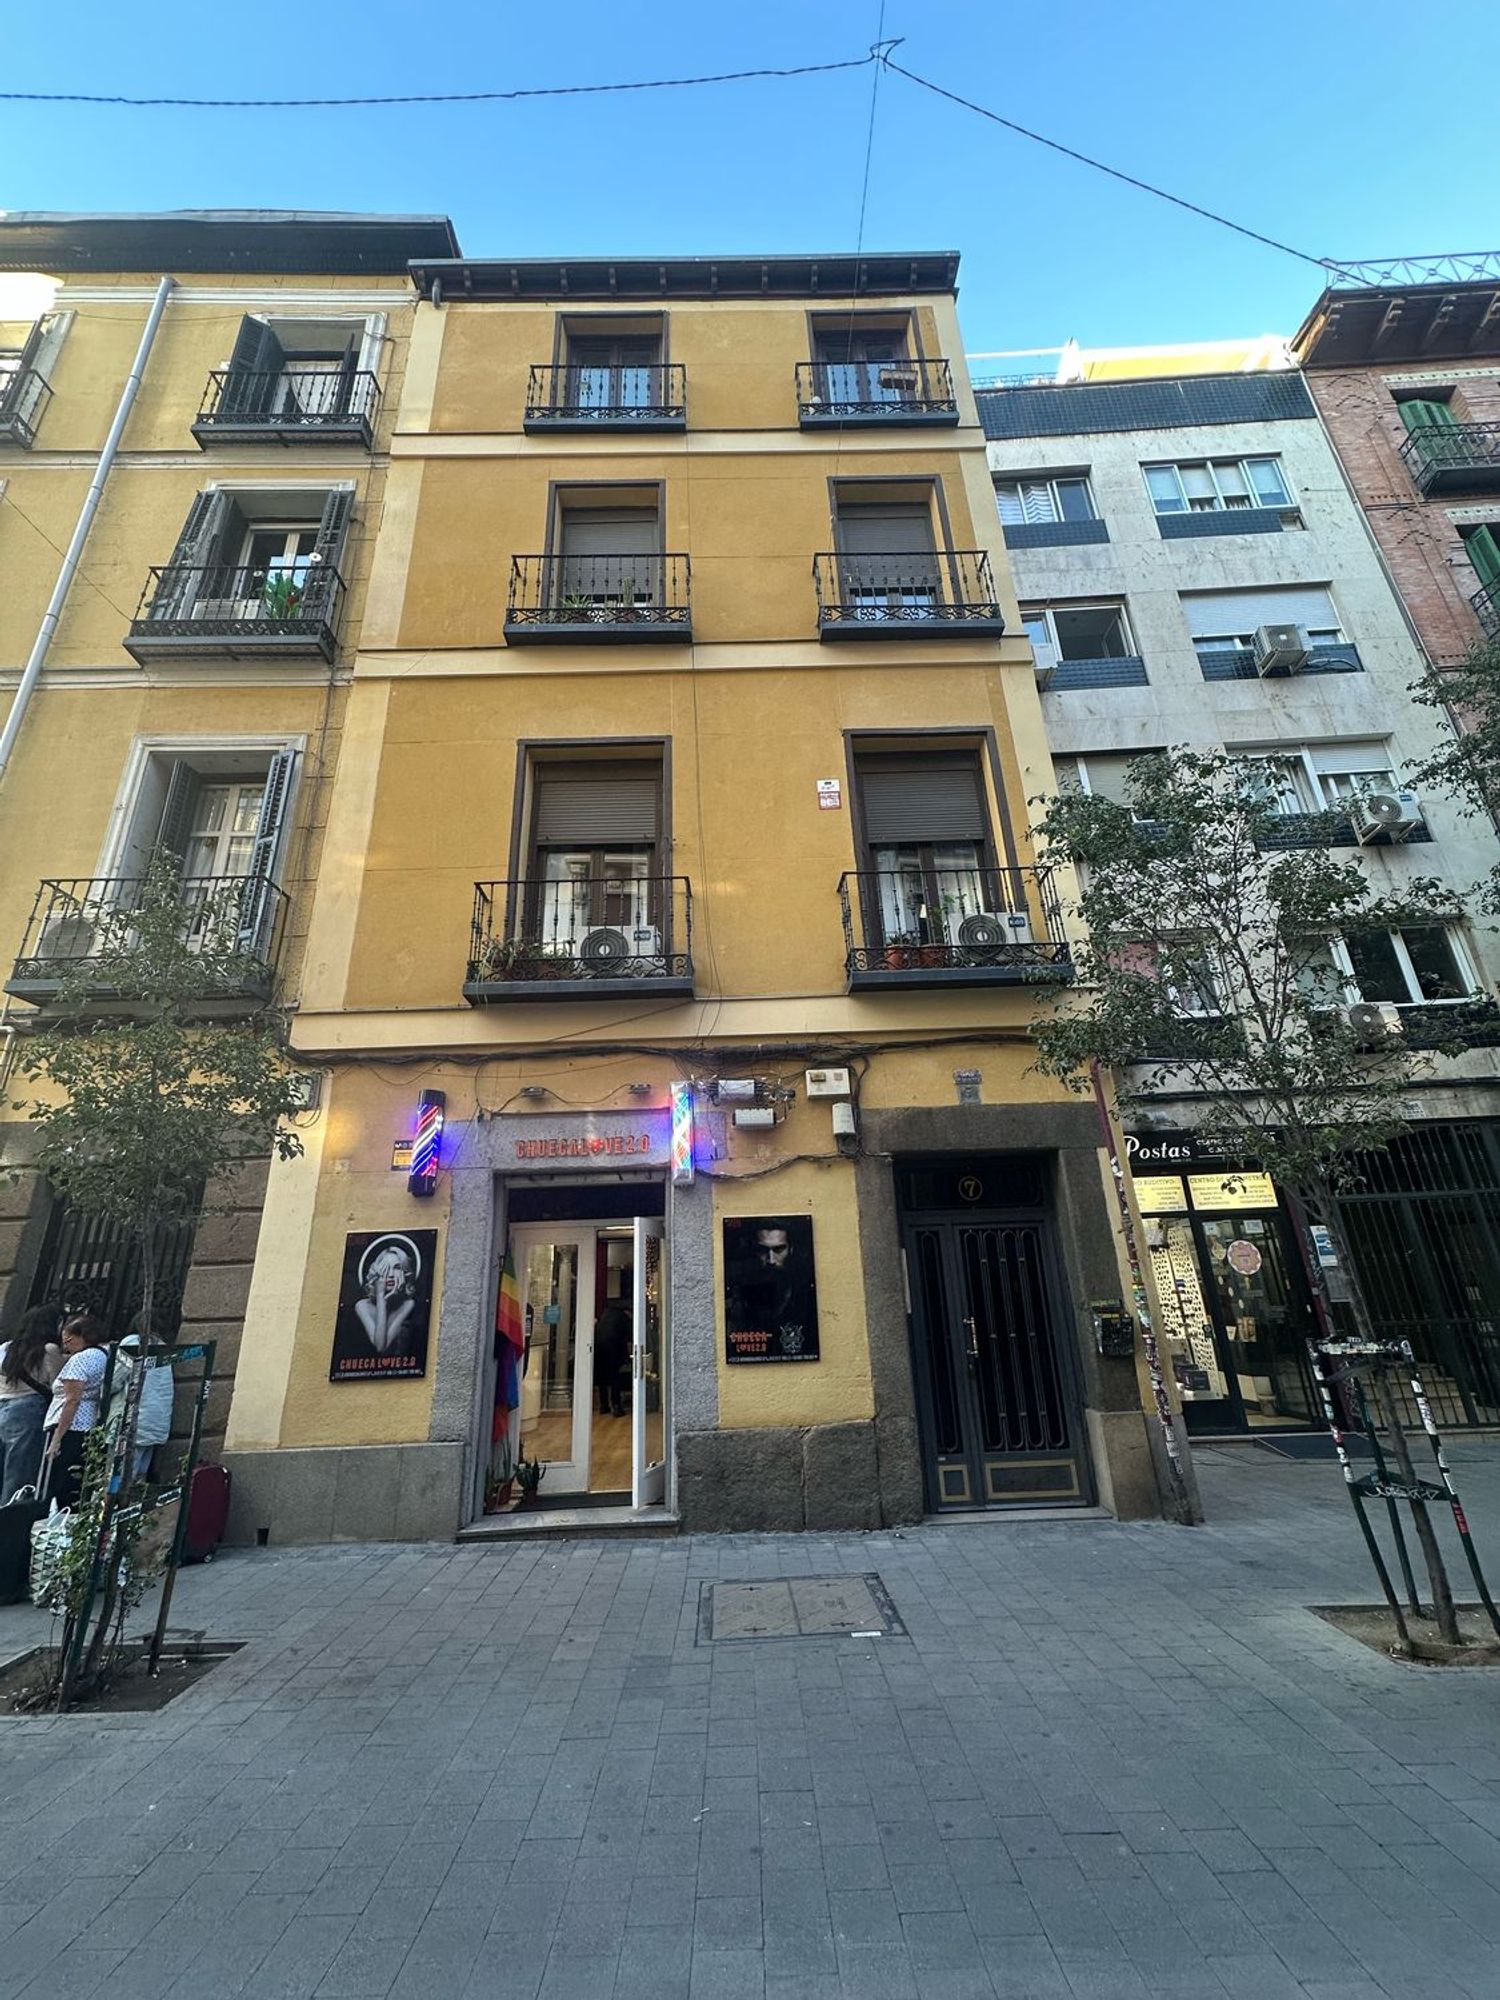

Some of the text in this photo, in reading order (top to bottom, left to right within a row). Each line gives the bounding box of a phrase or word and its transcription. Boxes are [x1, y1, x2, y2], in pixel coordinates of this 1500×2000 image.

[1123, 1135, 1191, 1158] Postas
[964, 1180, 976, 1197] 7
[340, 1358, 376, 1370] CHUECA
